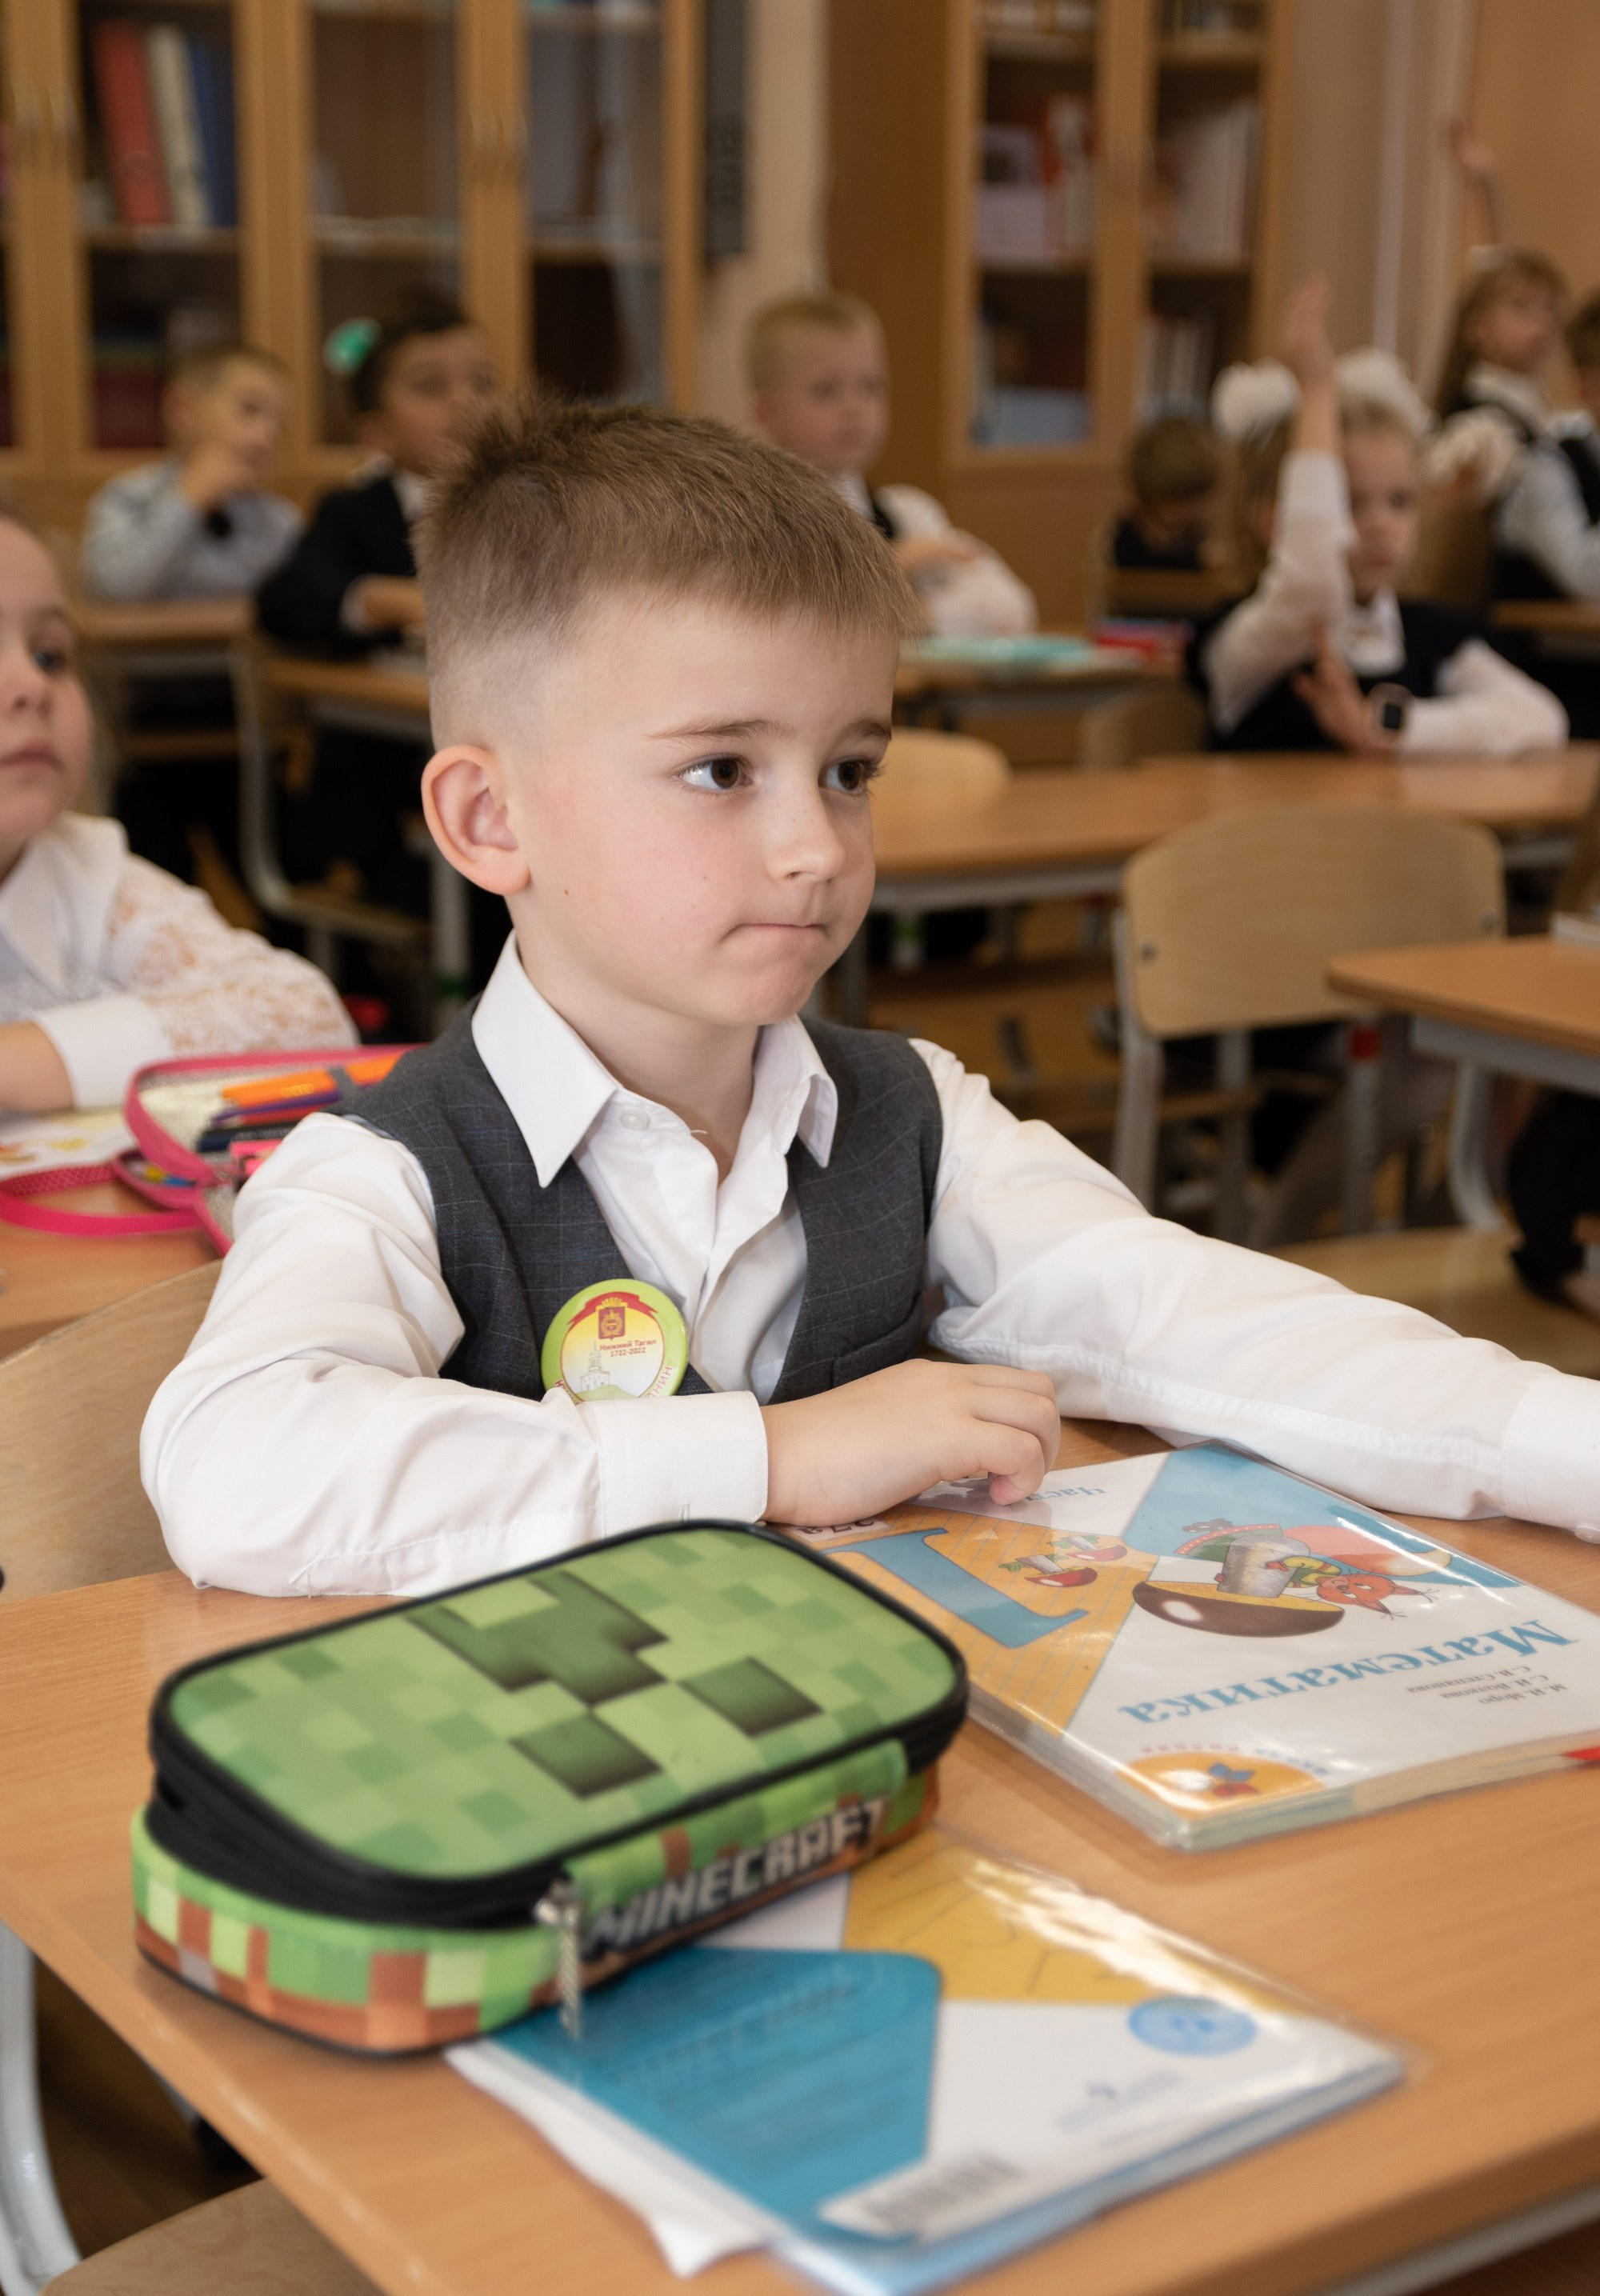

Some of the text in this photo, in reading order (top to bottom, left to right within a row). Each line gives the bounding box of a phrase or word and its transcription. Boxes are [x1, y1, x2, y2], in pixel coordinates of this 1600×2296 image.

[600, 1339, 657, 1350] Нижний Тагил
[610, 1347, 646, 1357] 1722-2022
[1118, 1619, 1579, 1724] Математика
[1406, 1674, 1496, 1694] Степанова
[1440, 1682, 1510, 1698] Волкова
[582, 1797, 885, 1957] MINECRAFT
